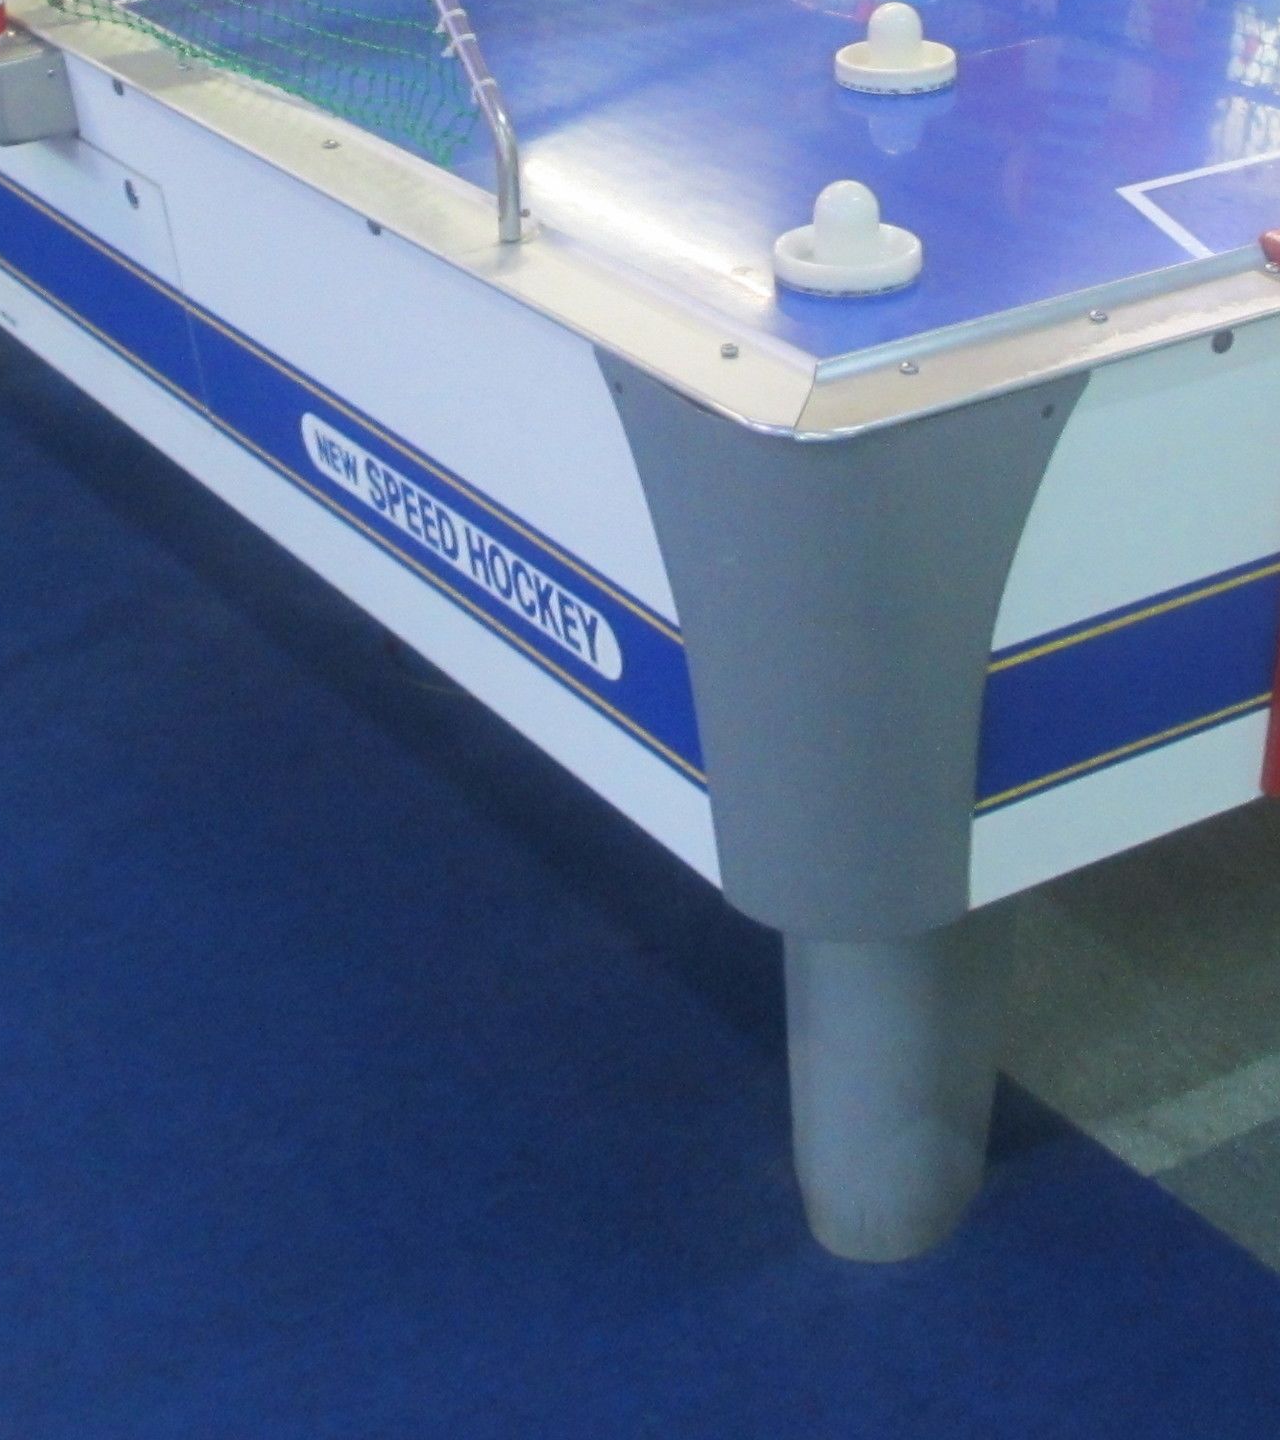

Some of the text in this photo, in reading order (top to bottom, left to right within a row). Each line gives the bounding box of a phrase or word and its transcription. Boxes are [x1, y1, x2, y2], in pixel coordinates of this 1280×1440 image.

[313, 426, 600, 666] NEW SPEED HOCKEY
